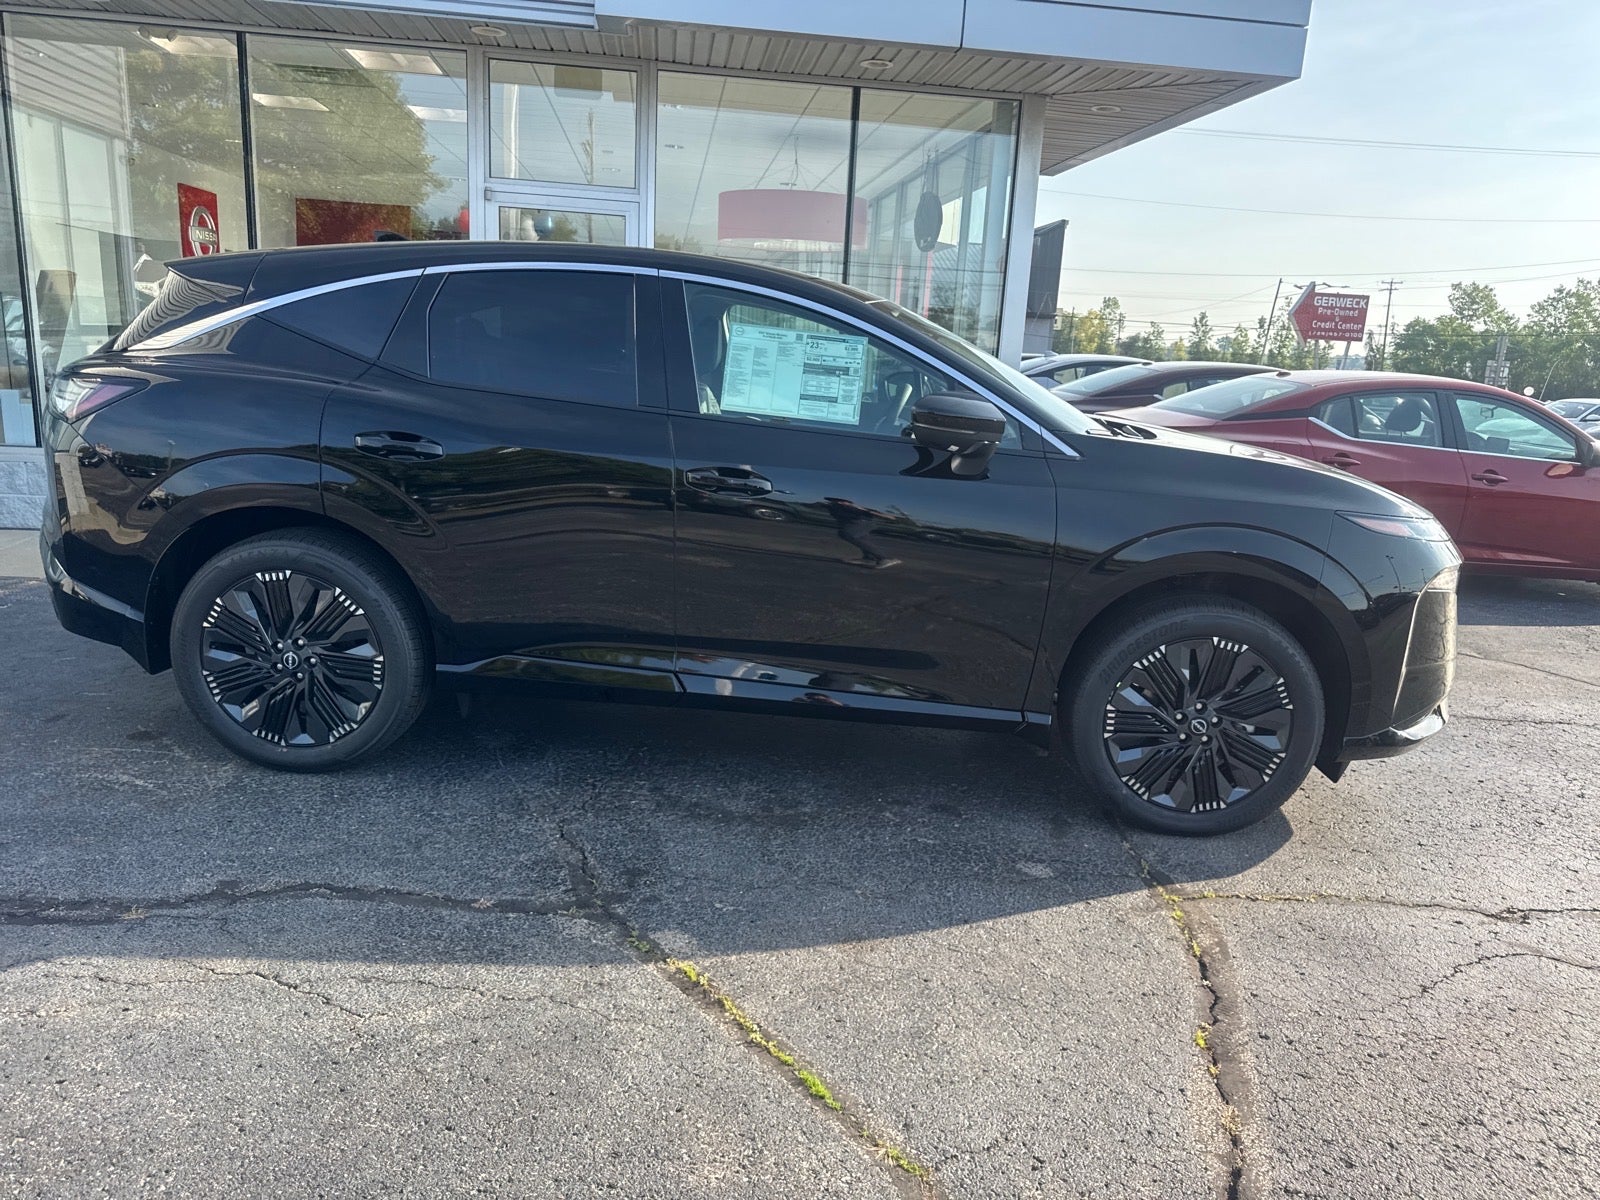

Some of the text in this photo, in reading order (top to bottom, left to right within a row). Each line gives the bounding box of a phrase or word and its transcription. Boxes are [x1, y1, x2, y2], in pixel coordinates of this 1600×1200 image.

[1314, 296, 1367, 308] GERWECK
[1318, 307, 1358, 316] Pre-Owned
[1312, 321, 1362, 330] Credit Center
[809, 341, 820, 349] 23
